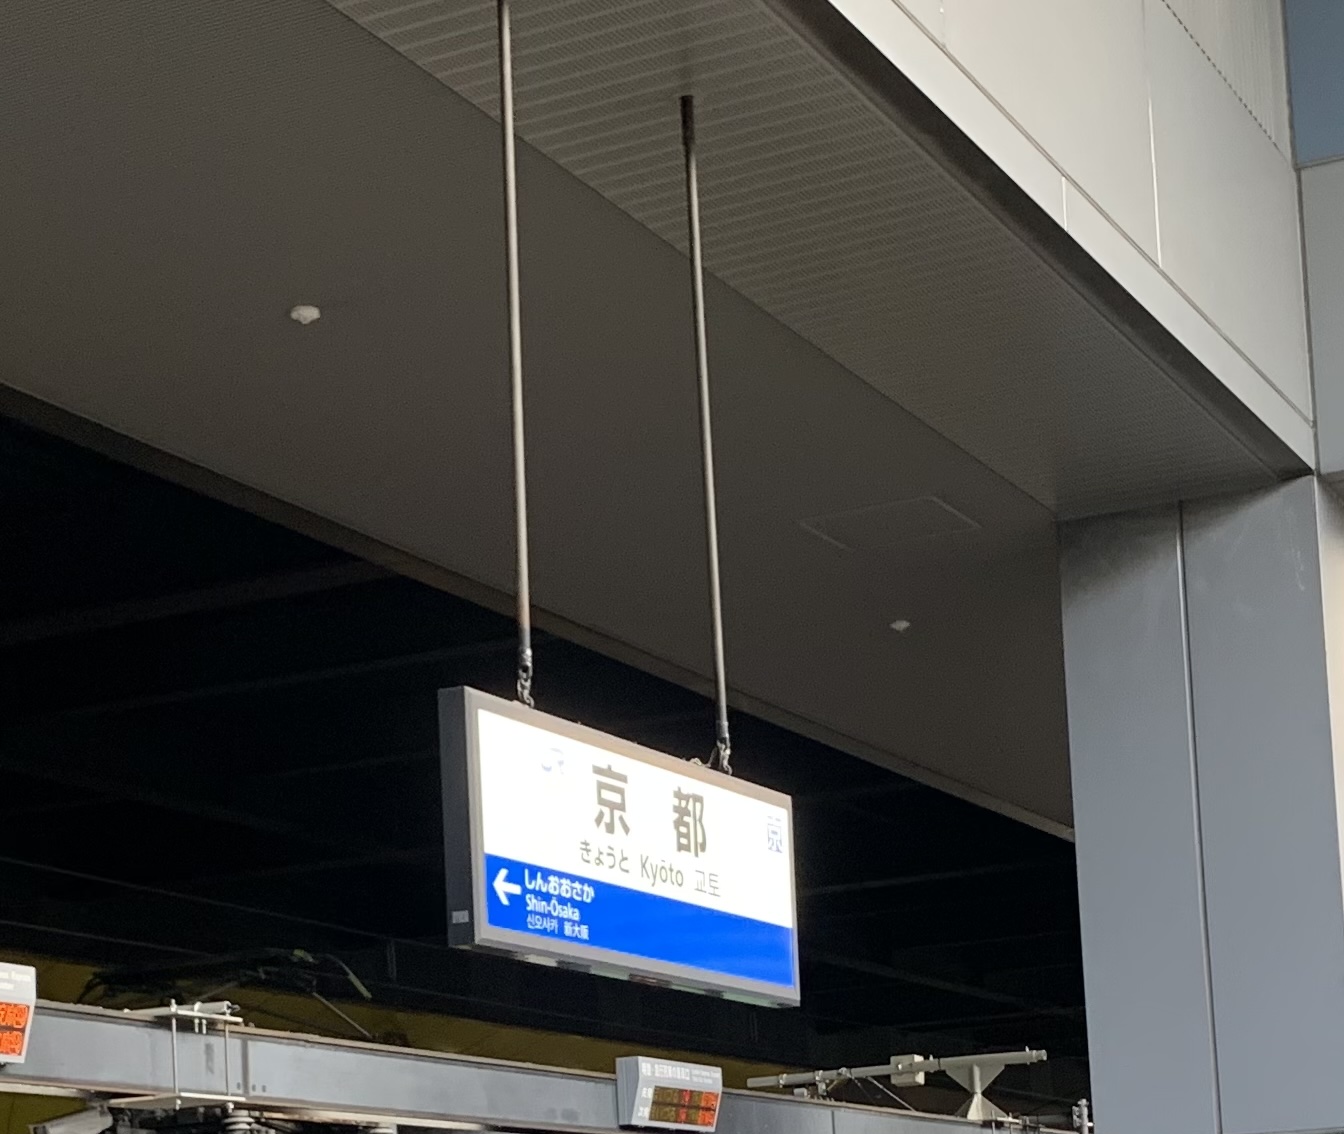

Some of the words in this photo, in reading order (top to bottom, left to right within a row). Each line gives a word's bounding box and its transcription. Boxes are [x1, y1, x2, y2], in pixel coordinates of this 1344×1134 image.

[592, 764, 707, 858] 京都
[524, 868, 595, 904] しんおおさか
[580, 839, 630, 874] きょうと
[640, 855, 685, 888] Kyōto
[694, 869, 721, 897] 교토
[525, 893, 581, 921] Shin-Ōsaka
